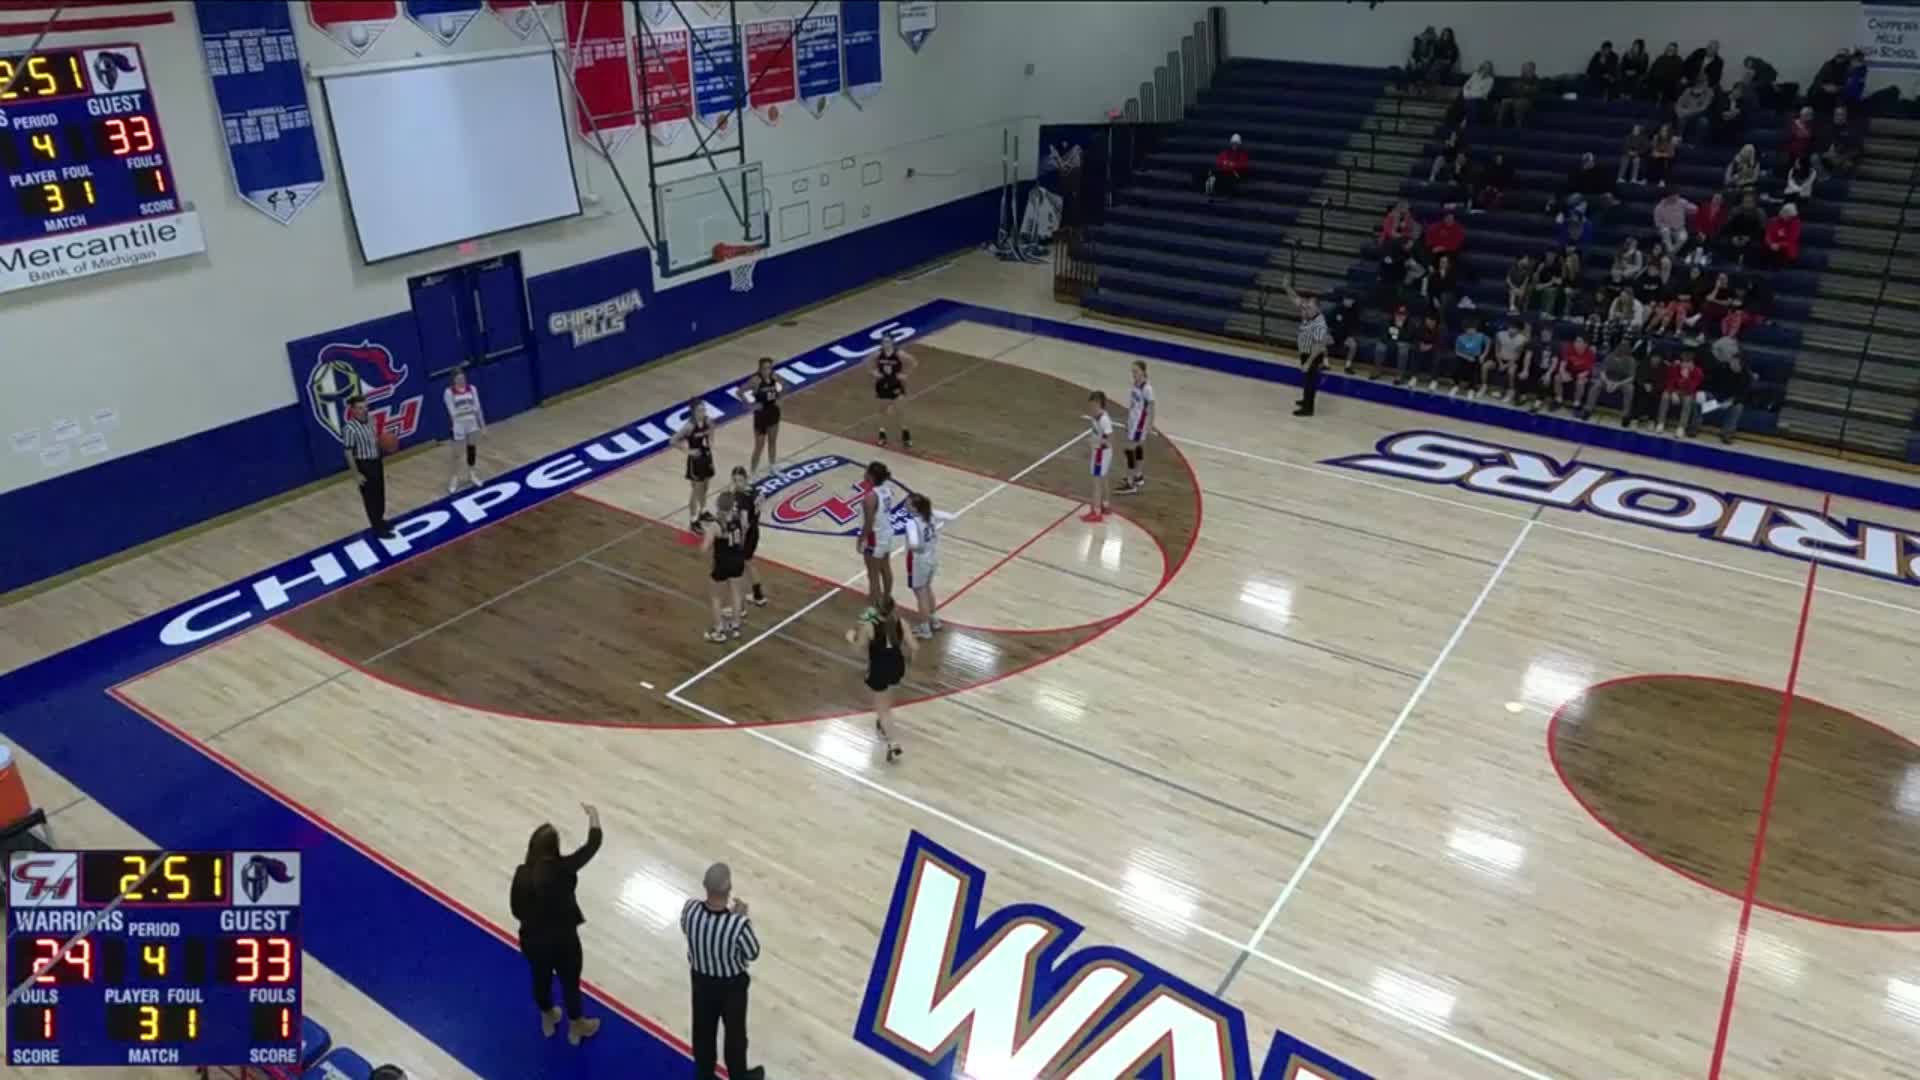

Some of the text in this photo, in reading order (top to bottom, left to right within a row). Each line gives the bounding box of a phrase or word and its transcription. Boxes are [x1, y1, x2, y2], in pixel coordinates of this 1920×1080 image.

[87, 94, 142, 117] GUEST
[13, 112, 59, 131] PERIOD
[32, 133, 56, 159] 4
[105, 115, 155, 155] 33
[127, 153, 164, 170] FOULS
[9, 164, 94, 188] PLAYER FOUL
[154, 170, 166, 193] 1
[139, 199, 176, 216] SCORE
[44, 214, 88, 233] MATCH
[0, 222, 178, 274] Mercantile
[28, 248, 157, 284] Bank of Michigan
[549, 288, 645, 336] CHIPPEWA
[572, 315, 627, 350] HILLS
[159, 400, 725, 648] CHIPPEWA
